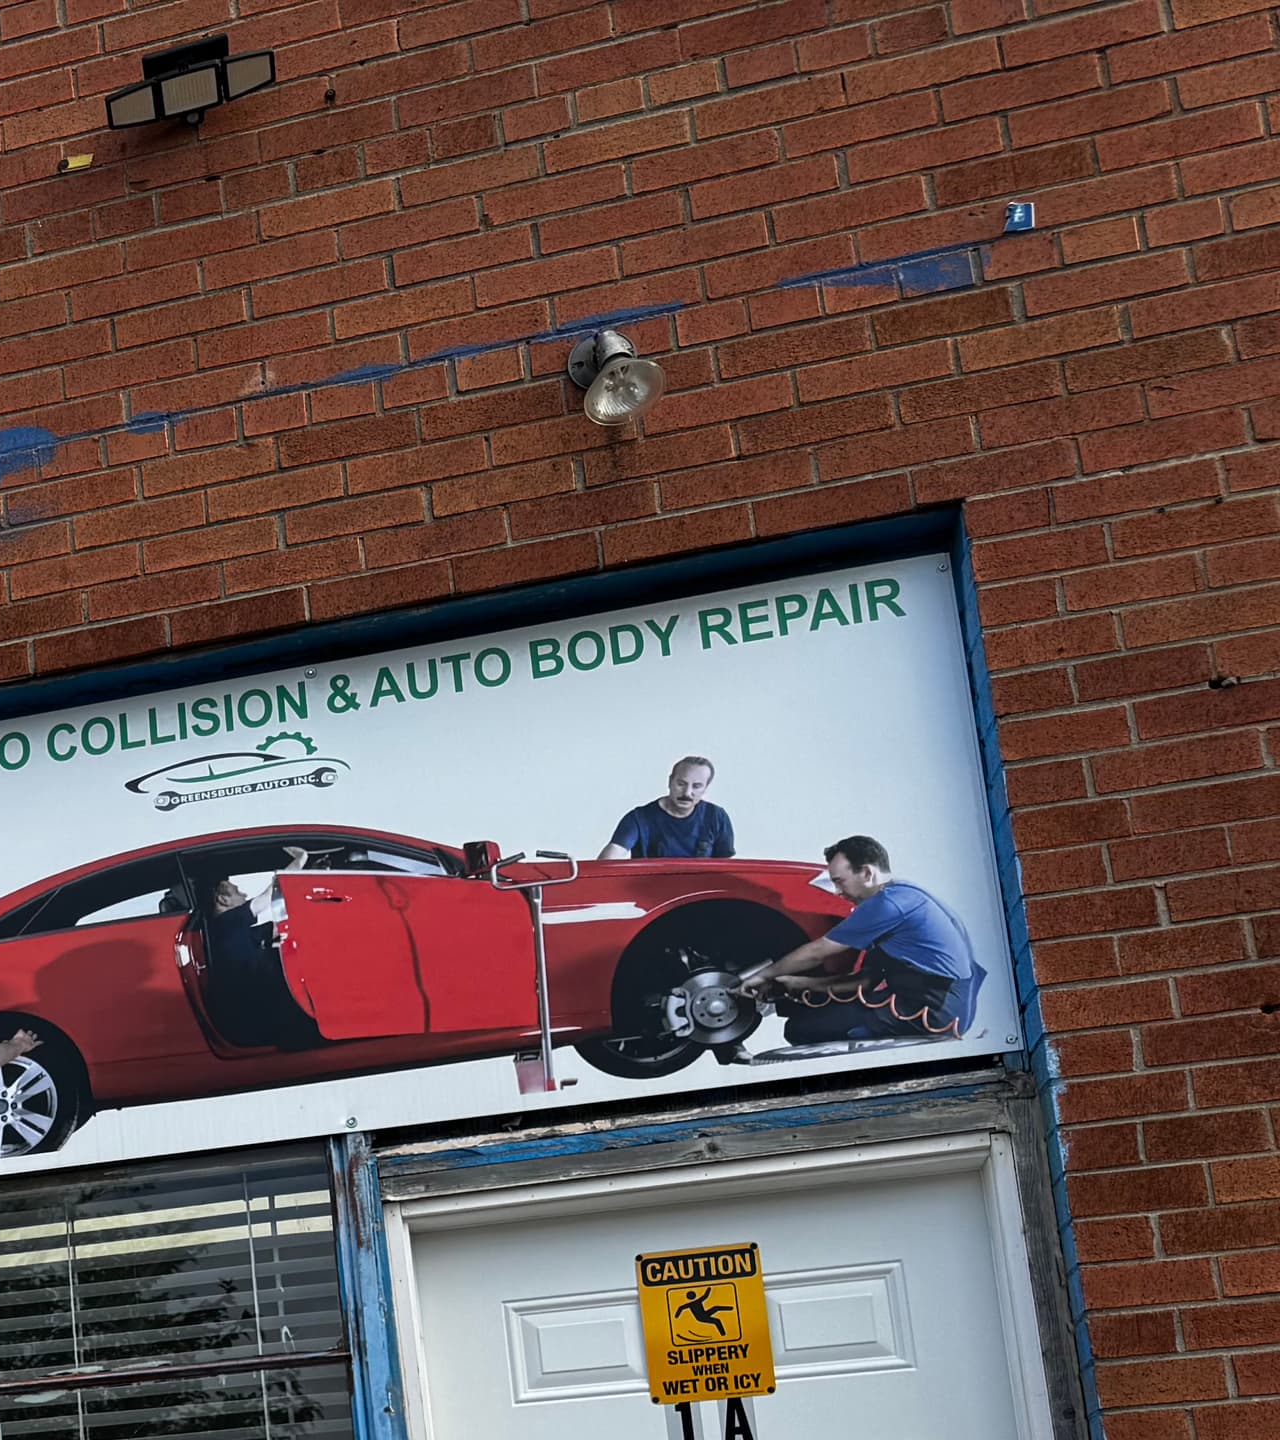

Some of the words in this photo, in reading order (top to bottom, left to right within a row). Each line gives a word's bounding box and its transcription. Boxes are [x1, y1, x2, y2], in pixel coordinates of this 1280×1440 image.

[46, 681, 309, 763] COLLISION
[327, 674, 361, 714] &
[369, 647, 511, 708] AUTO
[529, 615, 680, 680] BODY
[698, 578, 907, 650] REPAIR
[170, 785, 252, 805] GREENSBURG
[256, 779, 289, 791] AUTO
[293, 774, 319, 785] INC.
[646, 1252, 752, 1283] CAUTION
[667, 1344, 749, 1366] SLIPPERY
[692, 1363, 729, 1377] WHEN
[662, 1379, 699, 1396] WET
[705, 1376, 728, 1392] OR
[734, 1373, 761, 1389] ICY
